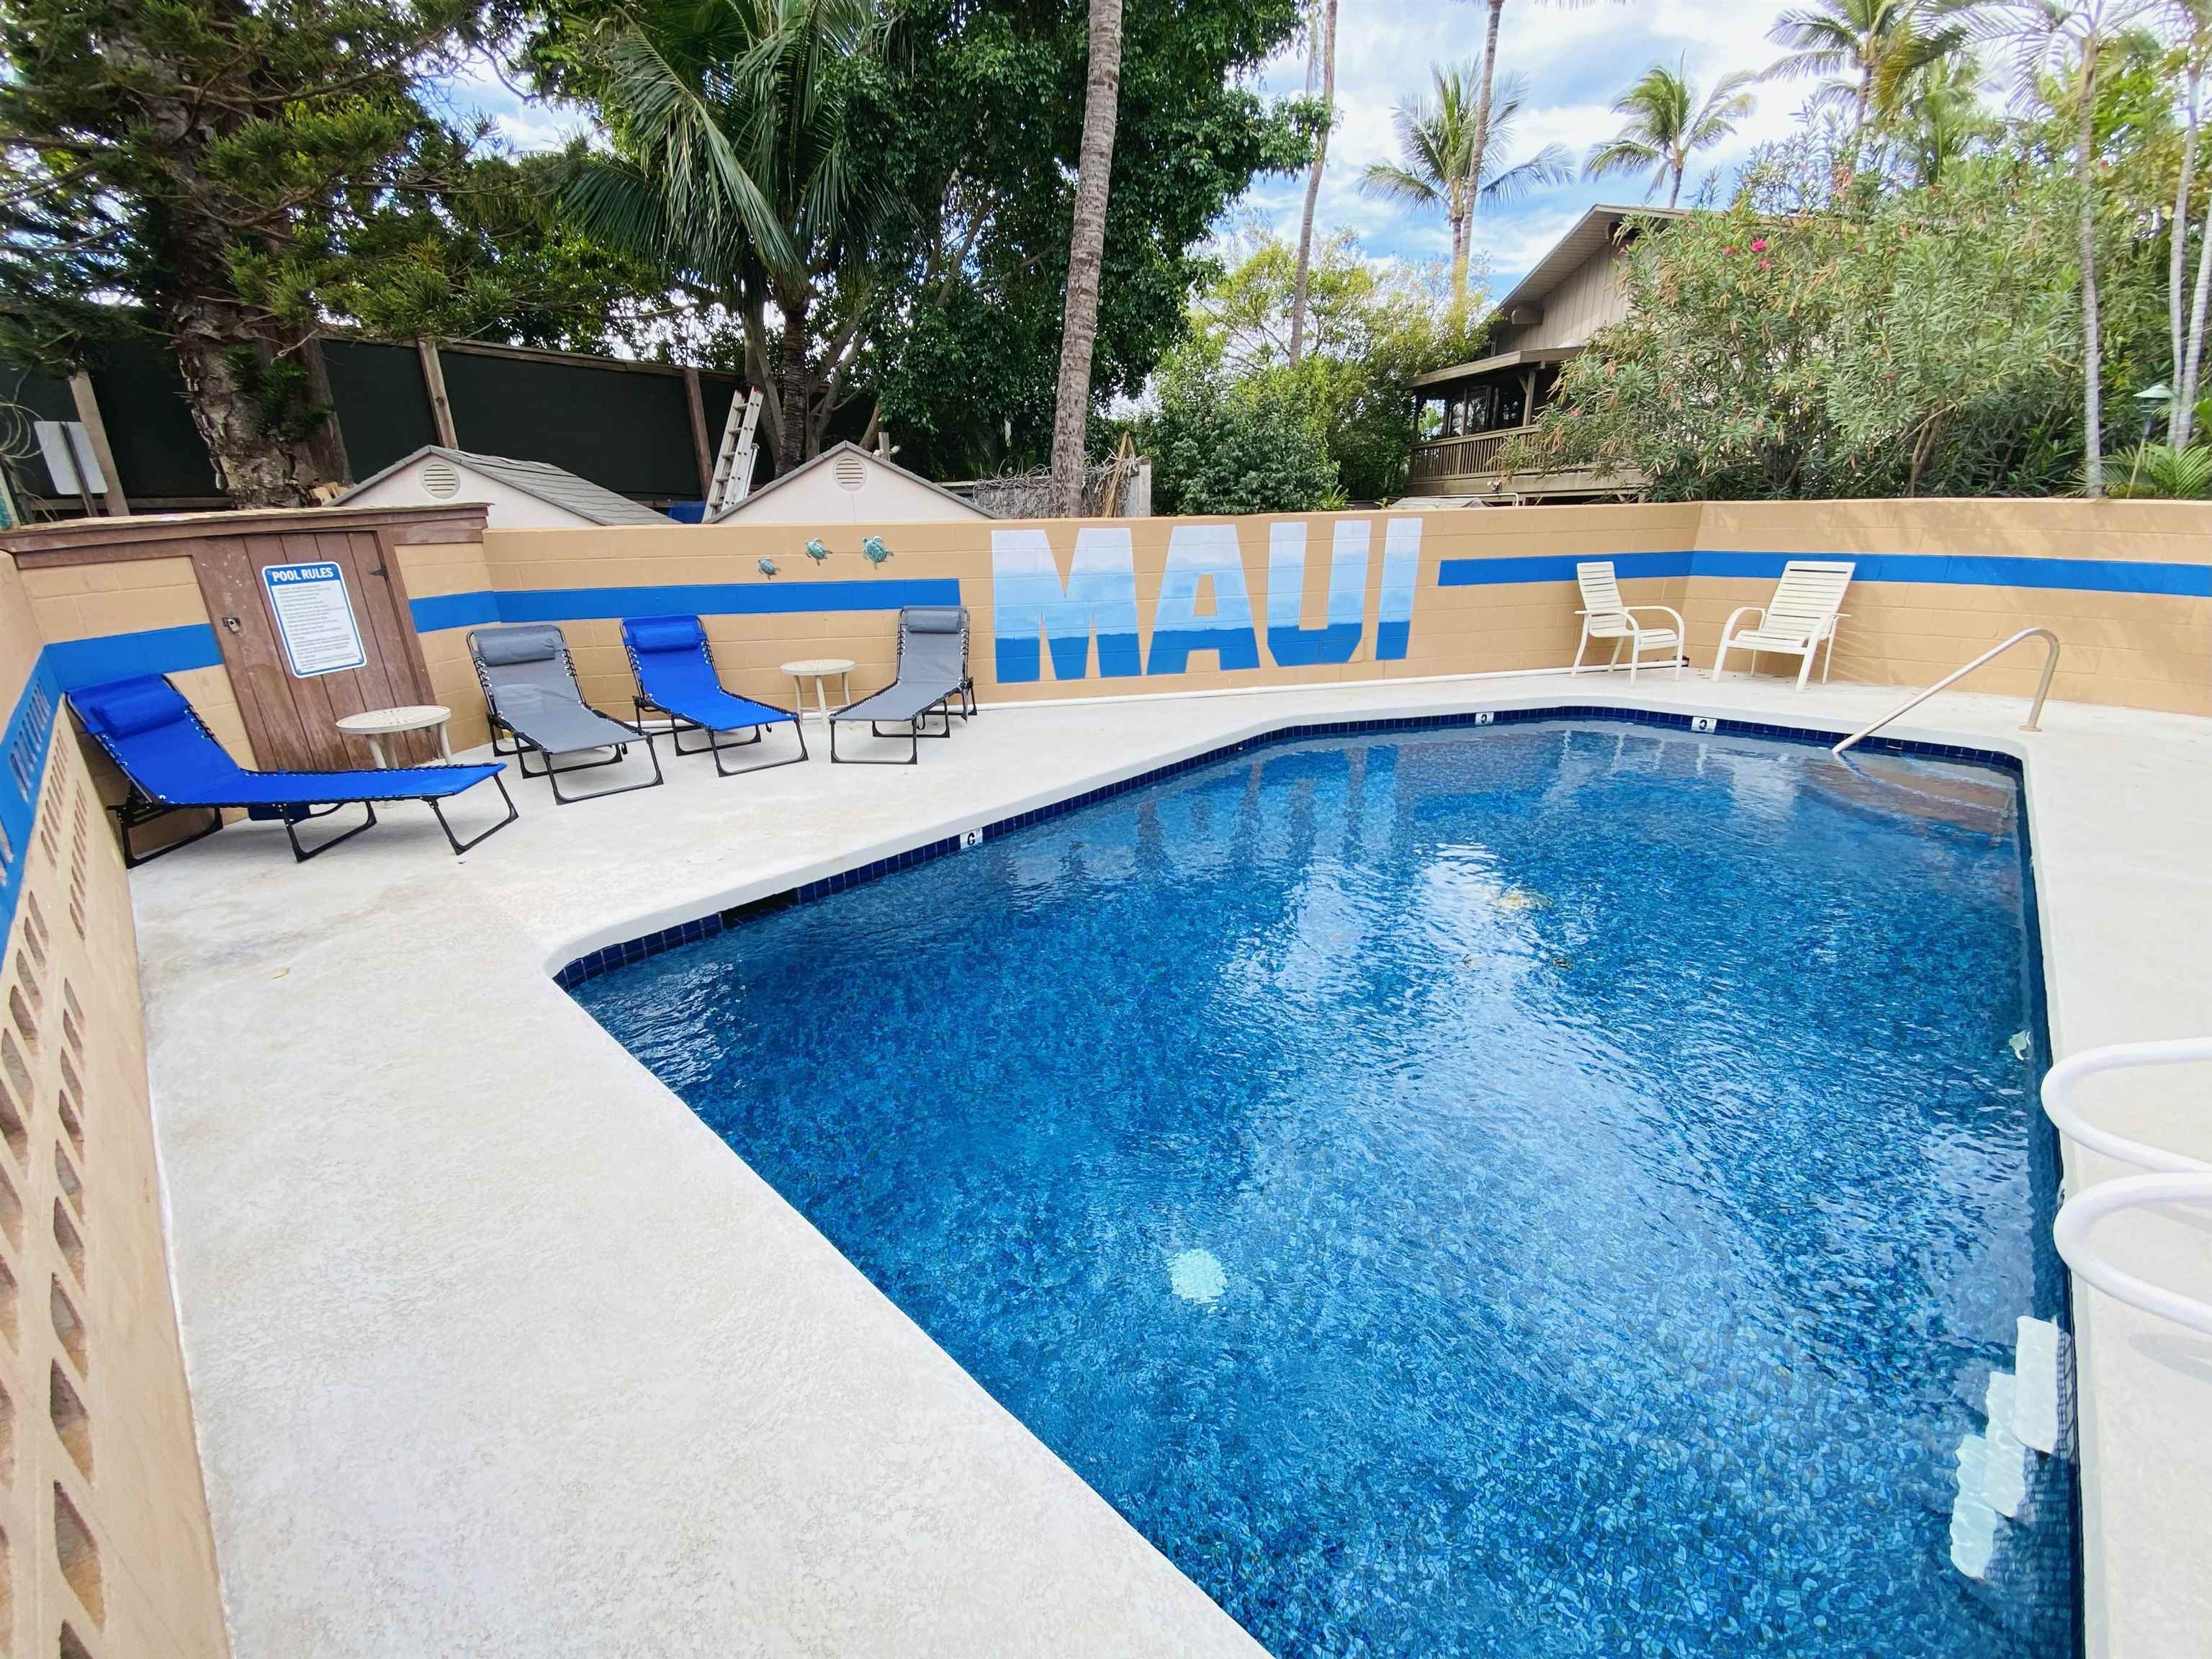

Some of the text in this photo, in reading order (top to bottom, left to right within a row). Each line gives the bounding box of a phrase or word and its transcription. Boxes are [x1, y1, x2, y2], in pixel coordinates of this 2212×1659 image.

[271, 567, 334, 582] POOL RULES
[992, 518, 1423, 683] MAUI
